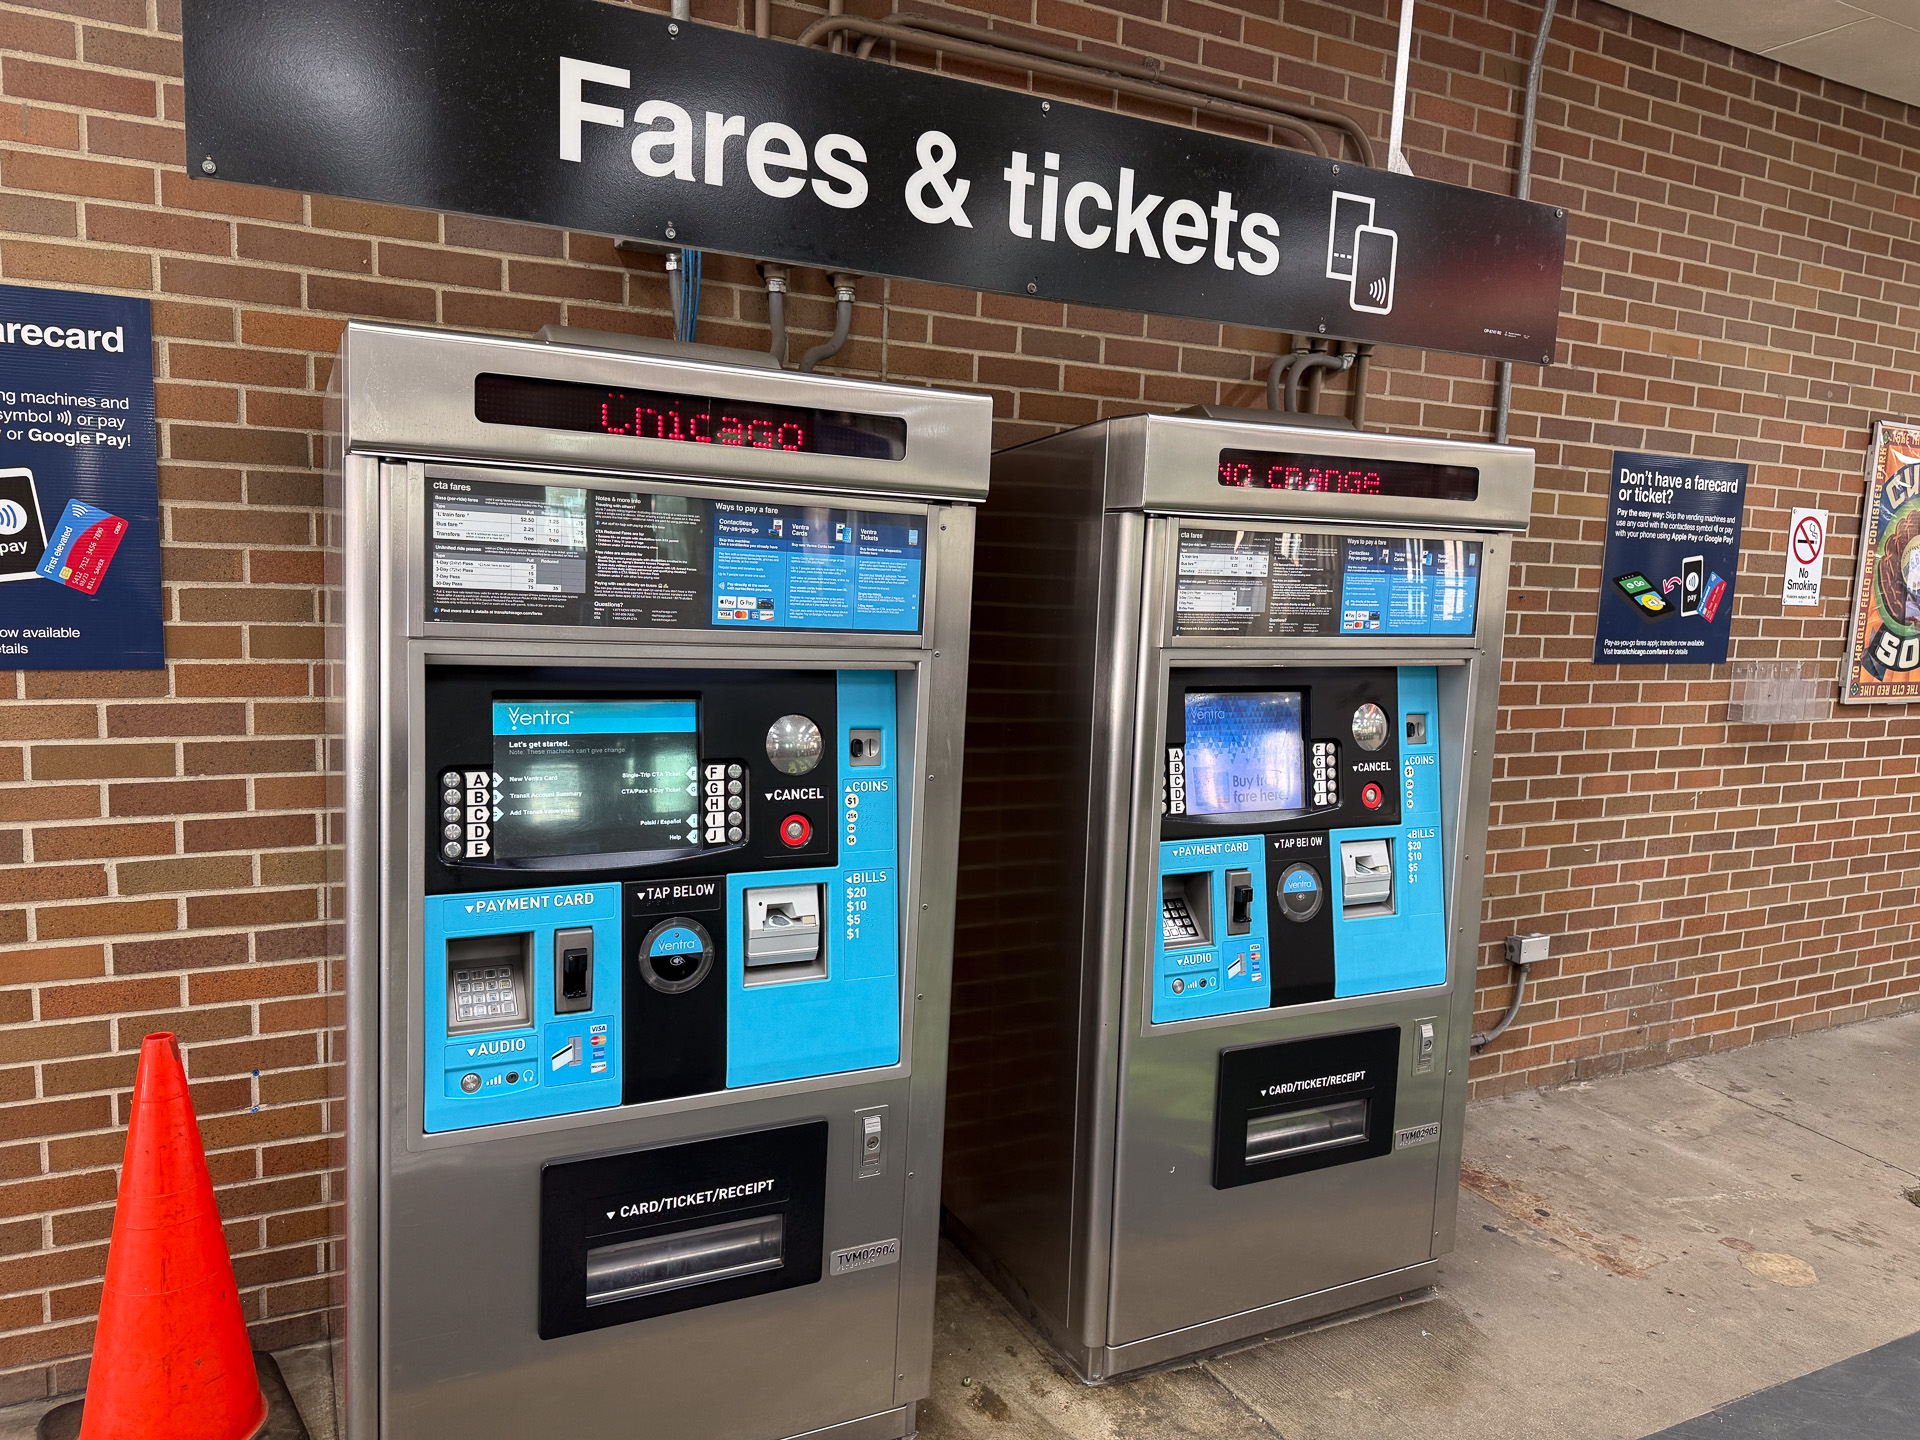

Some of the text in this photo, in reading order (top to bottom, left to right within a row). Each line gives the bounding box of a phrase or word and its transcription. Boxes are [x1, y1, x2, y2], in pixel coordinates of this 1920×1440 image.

[560, 56, 1280, 276] Fares & tickets
[0, 322, 124, 353] recard
[21, 392, 97, 407] machines
[100, 397, 130, 409] and
[77, 415, 93, 426] or
[98, 418, 126, 431] pay
[6, 428, 131, 450] or Google Pay!
[433, 481, 472, 492] cta fares
[1620, 468, 1739, 493] Don't have a farecard
[1619, 487, 1674, 504] or ticket?
[715, 502, 735, 511] Ways
[736, 503, 744, 511] to
[745, 505, 757, 514] pay
[764, 506, 779, 514] fare
[1617, 508, 1628, 516] Pay
[1638, 511, 1651, 519] easy
[1652, 512, 1665, 520] way:
[1665, 511, 1676, 520] Skip
[1686, 514, 1704, 522] vending
[1704, 515, 1726, 523] machines
[719, 518, 753, 527] Contactless
[791, 523, 810, 531] Ventra
[1669, 523, 1695, 531] contactless
[1696, 524, 1713, 533] symbol
[719, 525, 759, 534] Pay-as-you-go
[1640, 531, 1656, 540] phone
[1657, 532, 1671, 541] using
[1671, 533, 1687, 542] Apple
[1688, 534, 1698, 543] Pay
[1704, 535, 1722, 544] Google
[1723, 535, 1734, 545] Pay!
[0, 541, 28, 556] pay
[44, 525, 73, 574] First elevated
[1851, 448, 1888, 680] TO WRIGLEY FIELD AND COMISKEY PARK
[1798, 567, 1809, 578] No
[1787, 579, 1817, 593] Smoking
[1687, 594, 1697, 602] pay
[1614, 648, 1669, 656] transitchicago.com/fares
[1860, 683, 1919, 697] THE CTA RED LINE
[508, 707, 570, 730] Ventra
[1190, 707, 1225, 723] Ventra
[528, 741, 541, 749] get
[604, 747, 627, 755] change.
[1358, 761, 1391, 772] CANCEL
[1410, 756, 1435, 765] COINS
[622, 771, 651, 779] Single-Trip
[711, 767, 718, 778] F
[473, 775, 485, 787] A
[852, 781, 889, 792] COINS
[1232, 775, 1254, 789] Buy
[710, 783, 718, 794] G
[774, 788, 824, 800] CANCEL
[475, 791, 484, 803] B
[556, 791, 582, 799] Summary
[847, 797, 857, 805] $1
[1234, 790, 1257, 803] fare
[711, 798, 719, 810] H
[474, 808, 484, 821] C
[475, 826, 485, 838] D
[710, 830, 717, 841] J
[1411, 828, 1435, 839] BILLS
[475, 843, 484, 855] E
[1179, 842, 1249, 856] PAYMENT CARD
[1280, 838, 1295, 849] TAP
[1408, 840, 1421, 851] $20
[1408, 851, 1422, 862] $10
[1408, 863, 1418, 874] $5
[853, 872, 887, 884] BILLS
[1408, 874, 1418, 884] $1
[647, 884, 715, 899] TAP BELOW
[846, 887, 867, 899] $20
[476, 892, 594, 913] PAYMENT CARD
[846, 901, 867, 912] $10
[846, 914, 861, 926] $5
[846, 928, 860, 940] $1
[658, 939, 695, 954] Ventra
[1183, 953, 1212, 966] AUDIO
[477, 1039, 525, 1056] AUDIO
[1269, 1071, 1366, 1096] CARD/TICKET/RECEIPT
[1400, 1126, 1439, 1142] TVM02903
[619, 1179, 774, 1218] CARD/TICKET/RECEIPT
[837, 1243, 896, 1265] TVM02904
